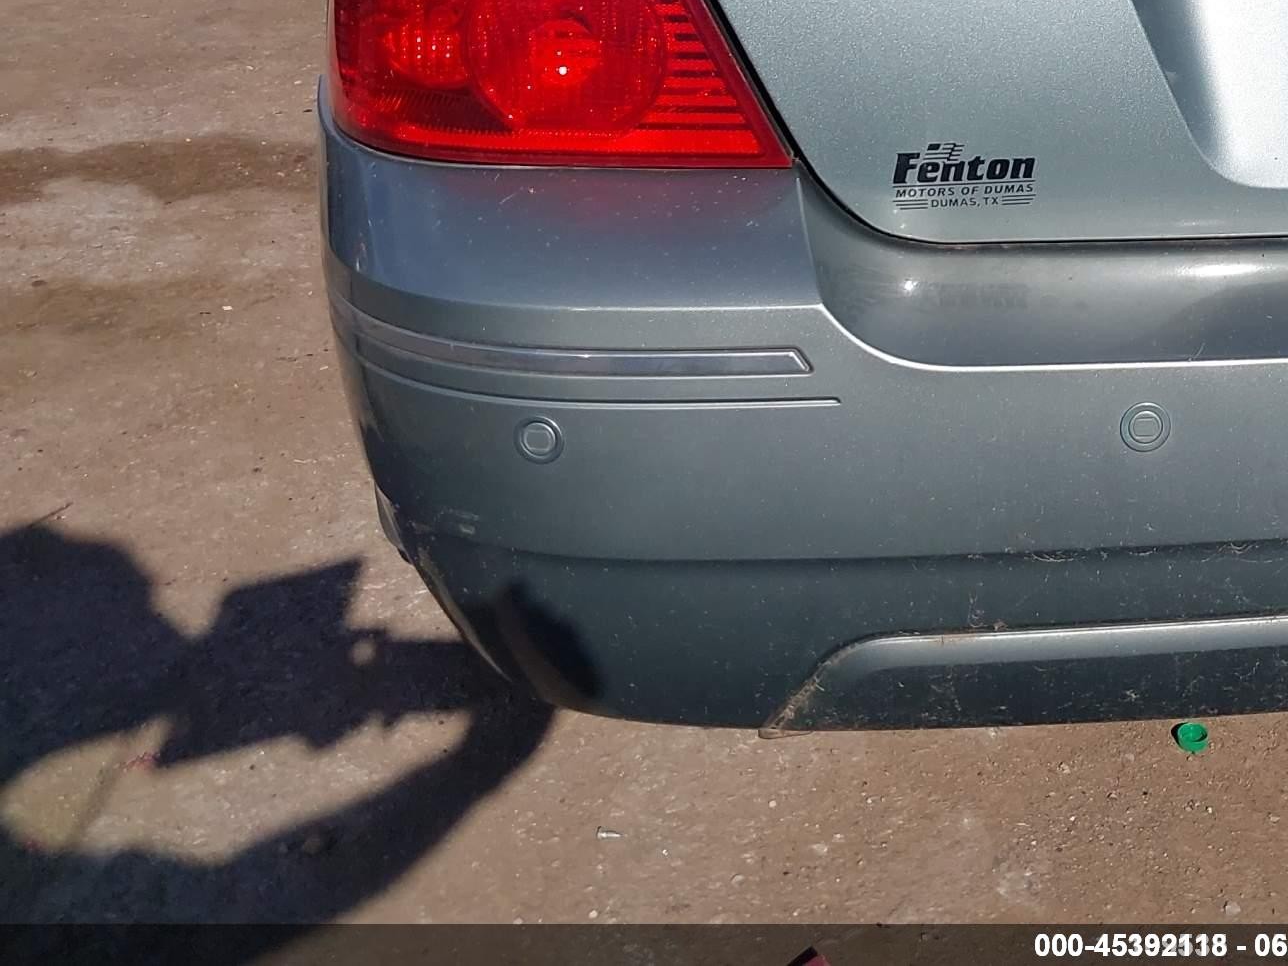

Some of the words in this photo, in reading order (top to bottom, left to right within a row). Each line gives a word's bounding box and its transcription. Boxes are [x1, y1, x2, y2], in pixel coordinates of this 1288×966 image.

[893, 152, 1035, 184] Fenton
[896, 187, 954, 198] MOTORS
[961, 186, 979, 195] OF
[984, 184, 1033, 194] DUMAS
[931, 197, 981, 208] DUMAS,
[983, 197, 999, 205] TX
